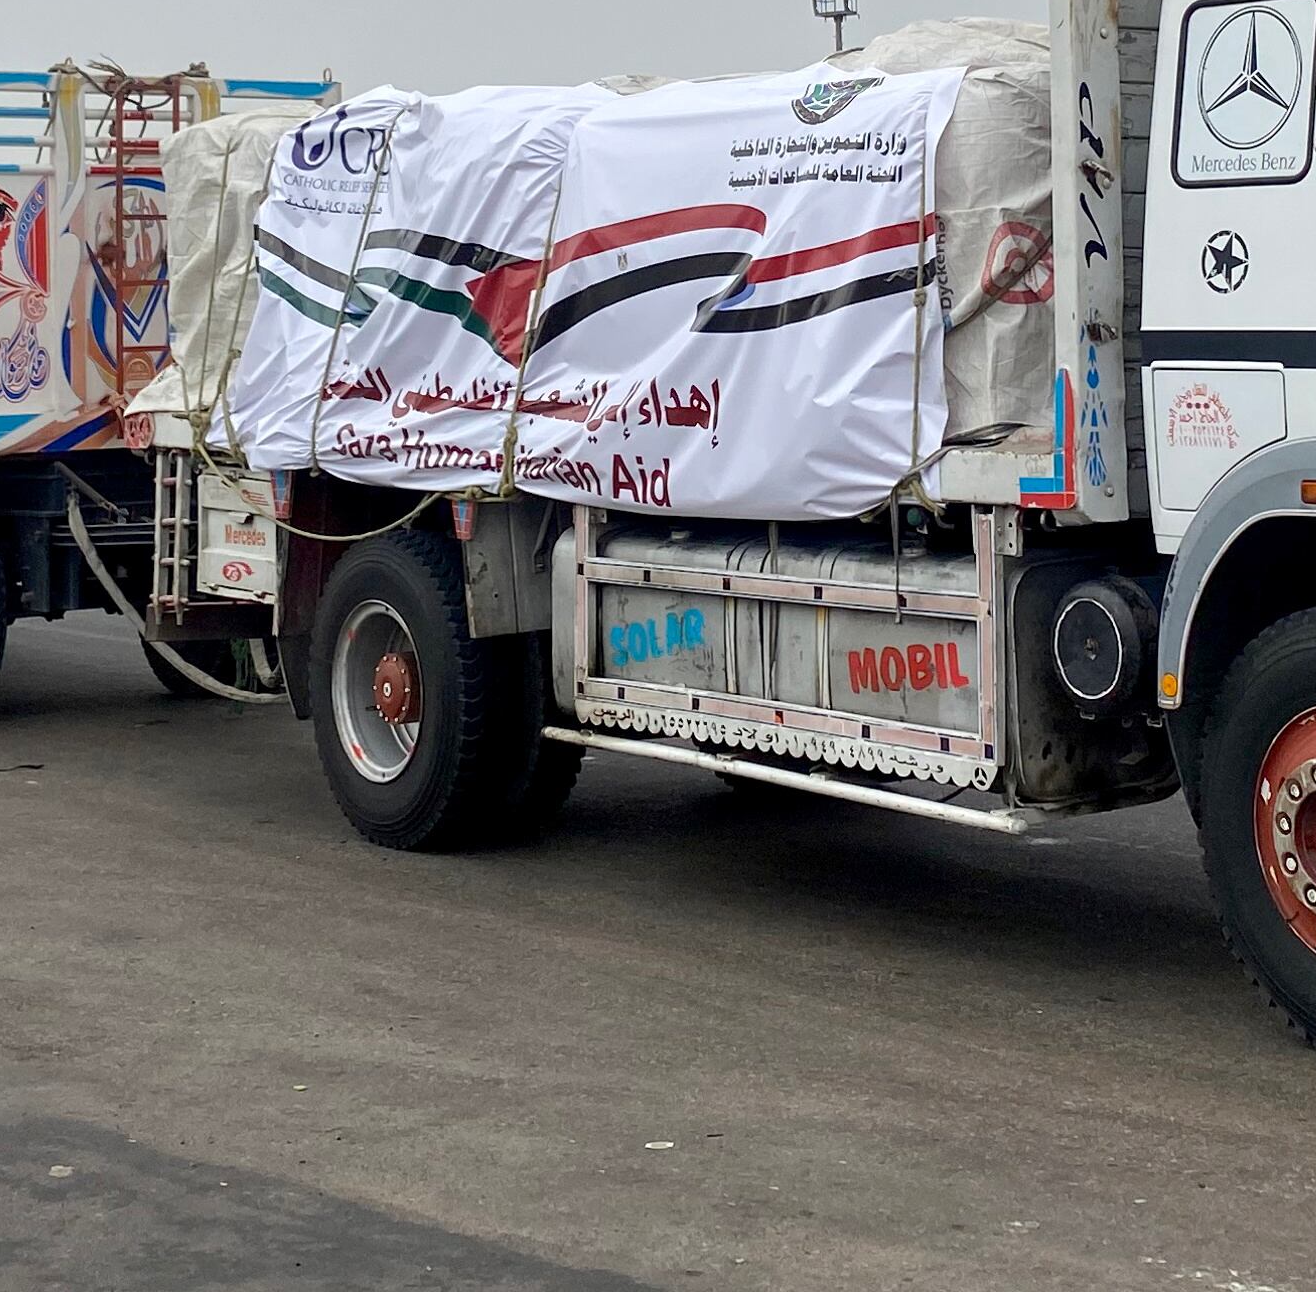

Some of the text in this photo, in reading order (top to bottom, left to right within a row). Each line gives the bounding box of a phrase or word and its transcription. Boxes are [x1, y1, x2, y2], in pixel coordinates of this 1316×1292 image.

[818, 132, 871, 155] التموين
[874, 132, 907, 155] وزارة
[822, 164, 863, 183] العامة
[1191, 152, 1296, 173] Mercedes Benz
[284, 174, 337, 192] CATHOLIC
[638, 375, 720, 449] إهداء
[612, 454, 672, 507] Aid
[224, 524, 266, 546] Mercedes
[610, 609, 705, 668] SOLAR
[848, 642, 970, 694] MOBIL
